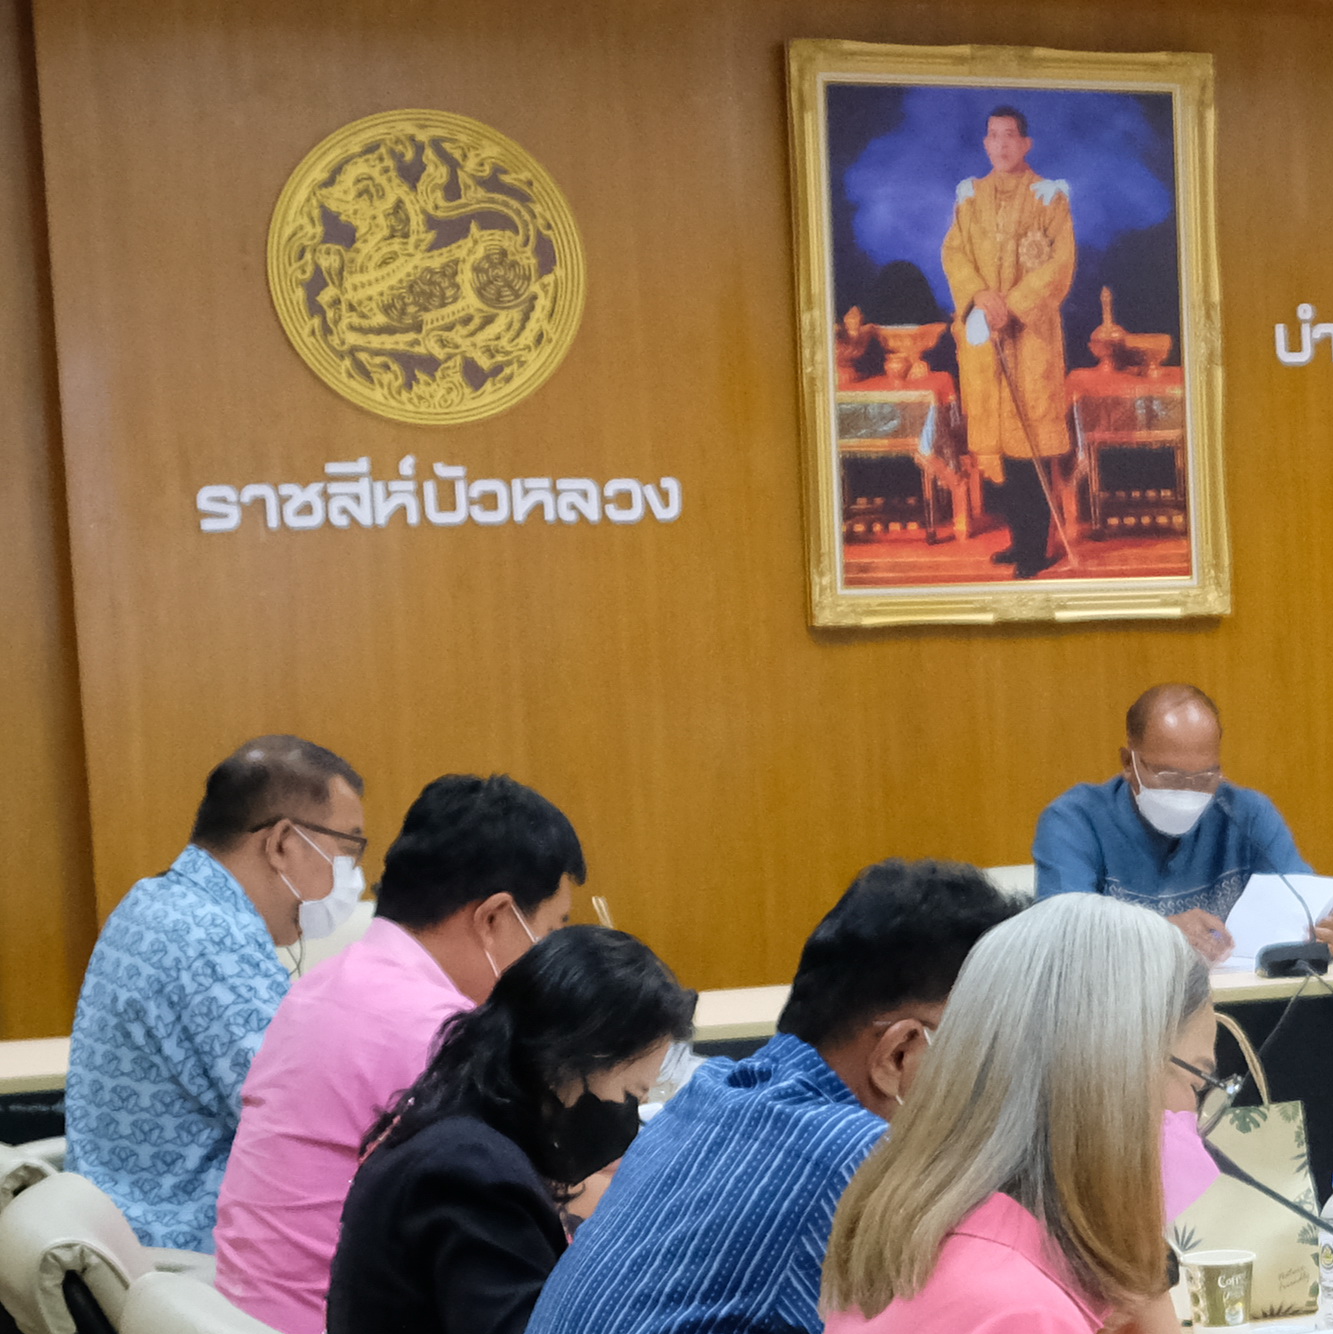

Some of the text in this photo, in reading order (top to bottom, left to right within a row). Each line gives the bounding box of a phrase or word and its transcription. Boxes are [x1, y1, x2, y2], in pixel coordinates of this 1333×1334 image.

[196, 454, 684, 532] ราชสีห์บัวหลวง
